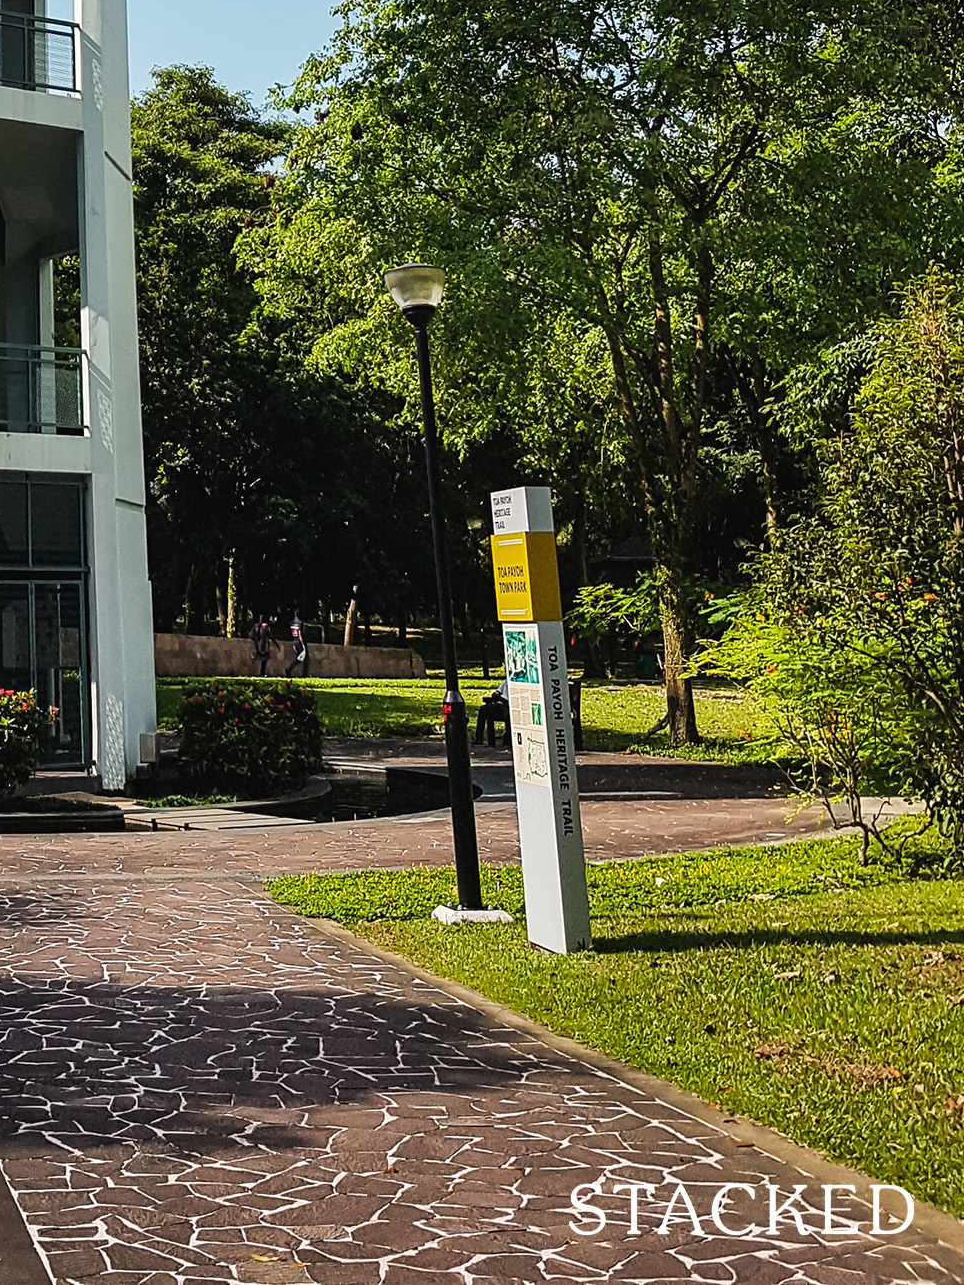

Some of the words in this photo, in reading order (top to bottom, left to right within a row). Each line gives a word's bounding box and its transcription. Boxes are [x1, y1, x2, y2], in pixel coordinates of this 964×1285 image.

[494, 508, 511, 517] HERITAGE
[495, 521, 505, 529] TRAIL
[498, 567, 507, 578] TOA
[507, 566, 523, 578] PAYOH
[499, 581, 514, 594] TOWN
[514, 581, 527, 593] PARK
[547, 645, 559, 672] TOA
[550, 678, 564, 720] PAYOH
[555, 728, 570, 790] HERITAGE
[561, 799, 574, 836] TRAIL
